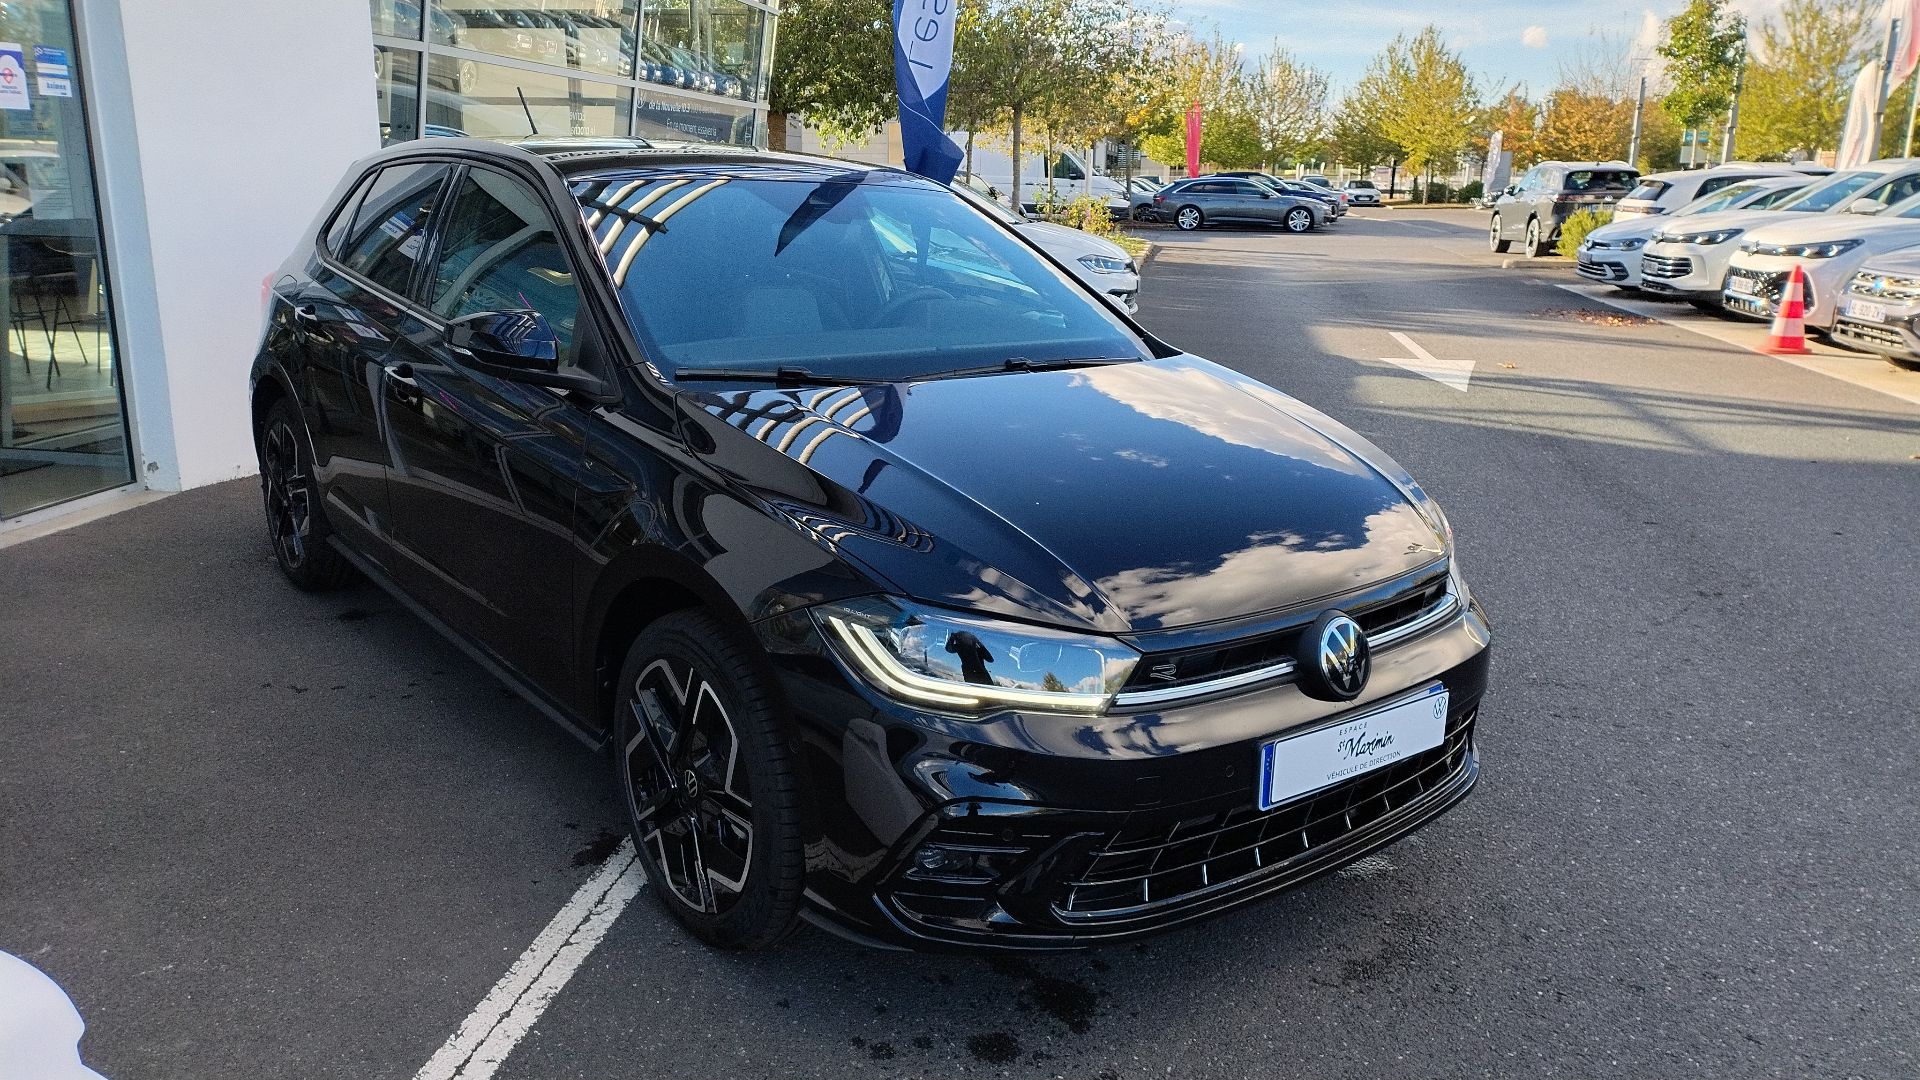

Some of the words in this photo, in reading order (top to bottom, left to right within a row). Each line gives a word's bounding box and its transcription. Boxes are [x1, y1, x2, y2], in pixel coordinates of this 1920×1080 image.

[1339, 721, 1368, 736] ESPACE
[1343, 730, 1395, 761] Maximin
[1326, 764, 1359, 781] VÉHICULE
[1360, 761, 1368, 770] DE
[1368, 749, 1401, 767] DIRECTION
